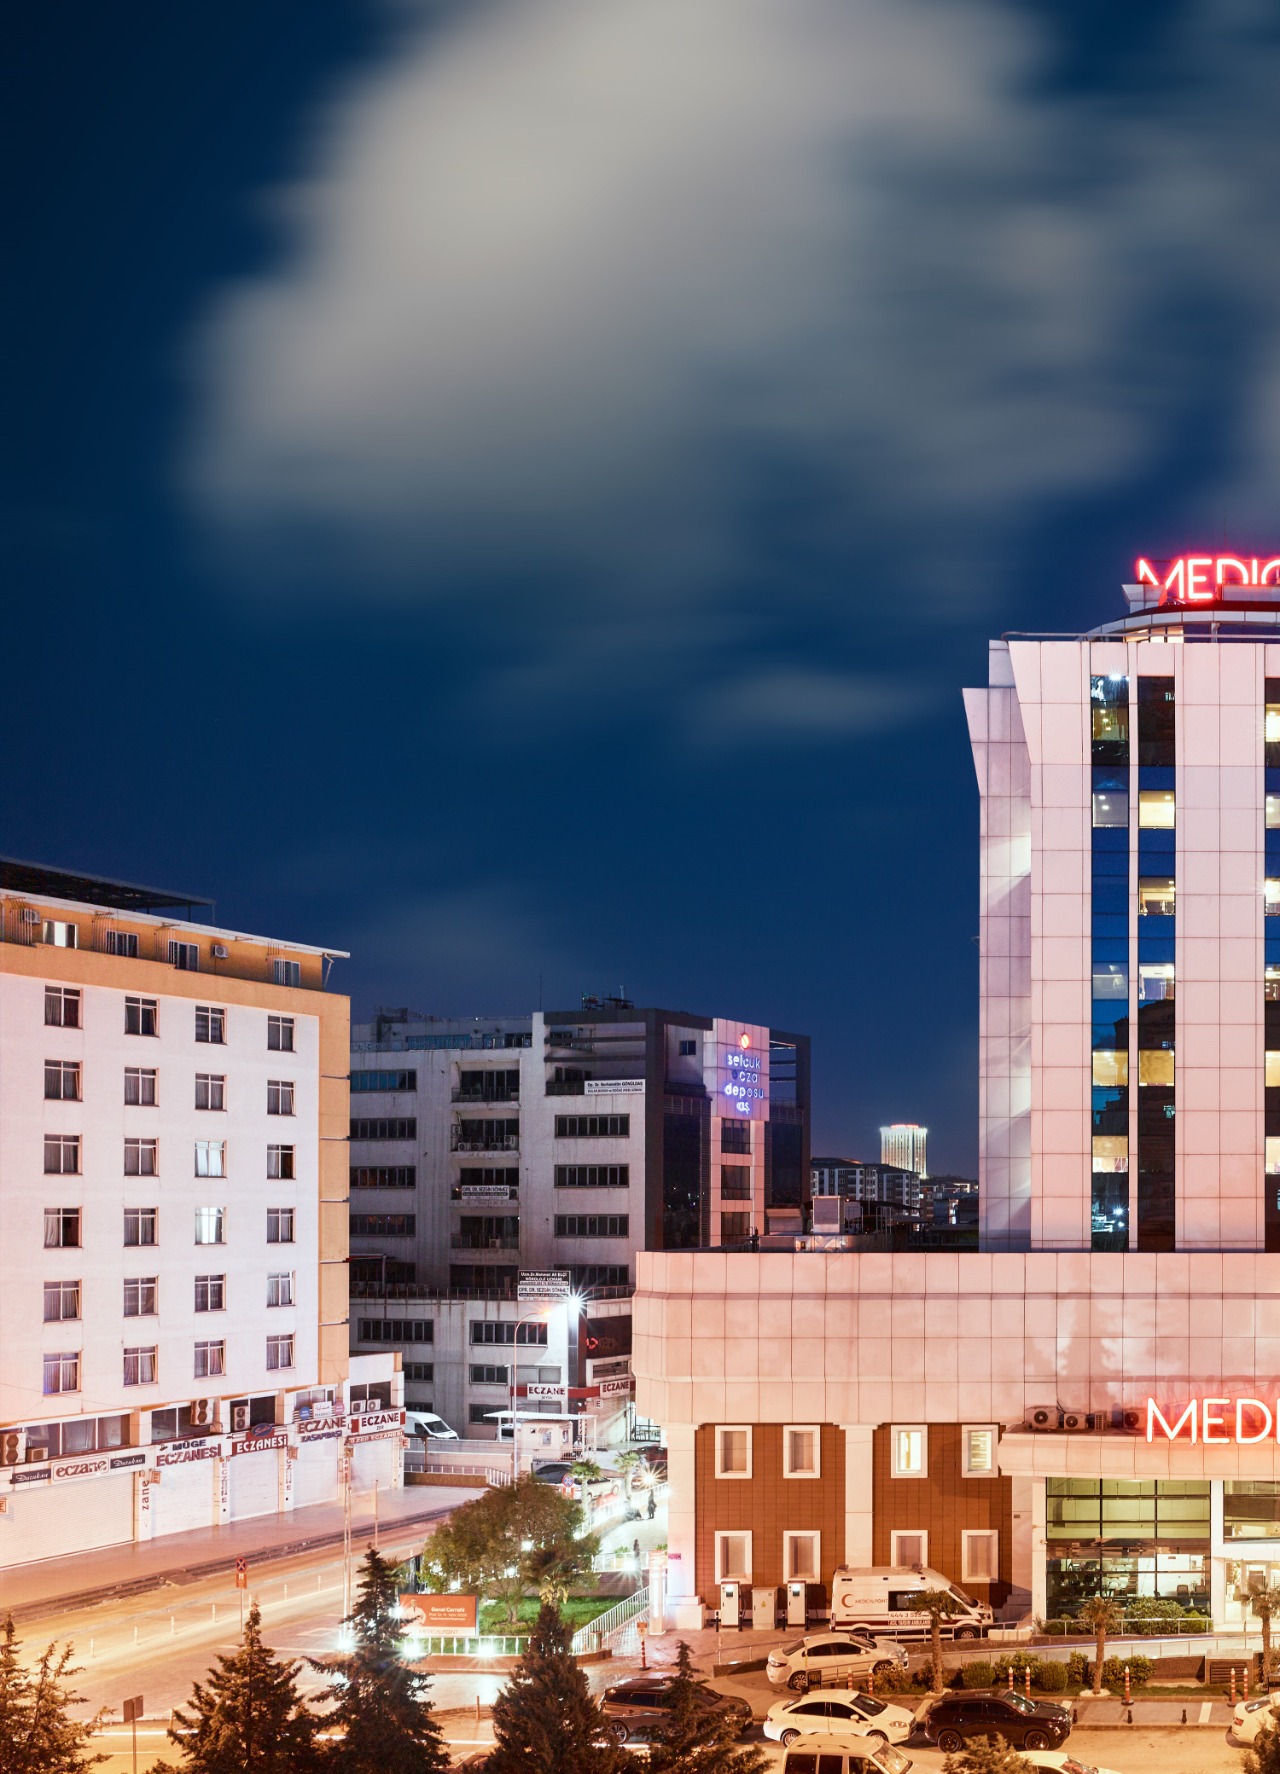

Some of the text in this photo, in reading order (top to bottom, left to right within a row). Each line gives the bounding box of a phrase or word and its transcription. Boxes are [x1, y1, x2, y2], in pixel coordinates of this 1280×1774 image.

[727, 1054, 760, 1070] selçuk
[724, 1083, 764, 1099] deposu
[528, 1386, 565, 1396] ECZANE
[602, 1380, 629, 1393] ECZANE
[297, 1416, 346, 1434] ECZANE
[361, 1412, 399, 1427] ECZANE
[172, 1439, 206, 1451] MÜGE
[56, 1460, 107, 1478] eczane
